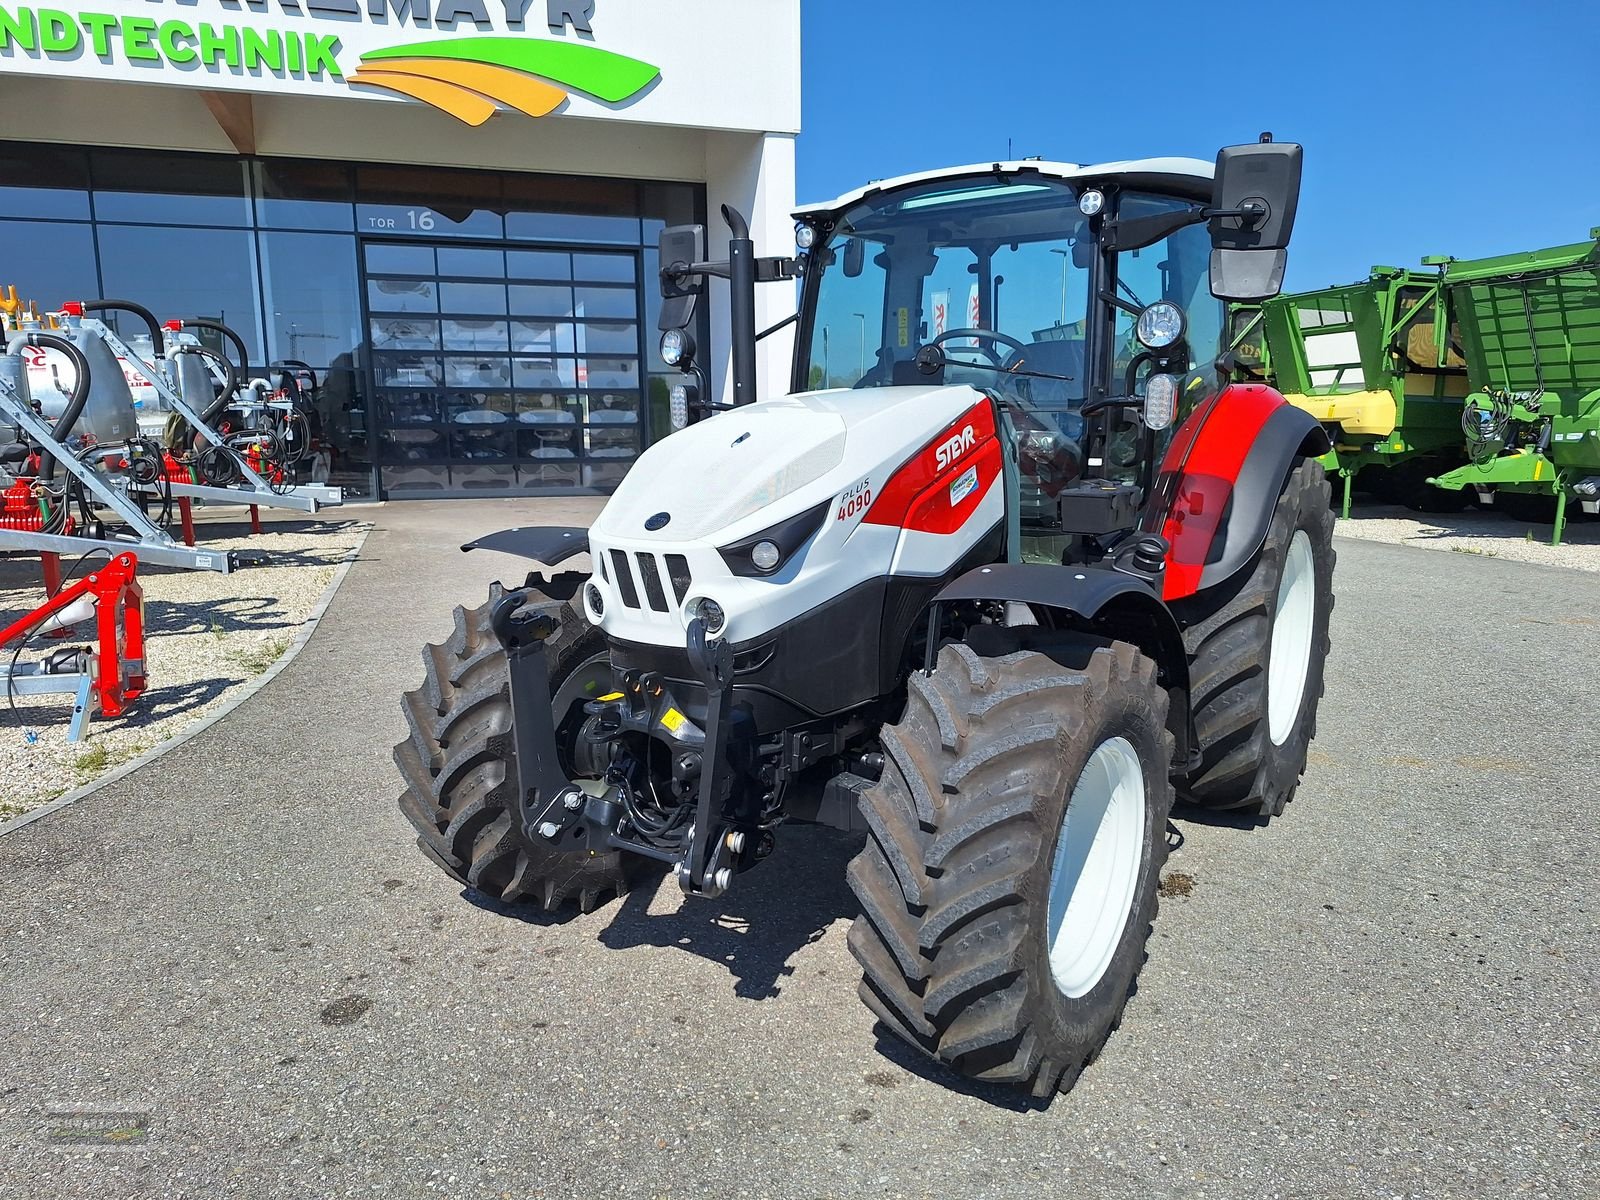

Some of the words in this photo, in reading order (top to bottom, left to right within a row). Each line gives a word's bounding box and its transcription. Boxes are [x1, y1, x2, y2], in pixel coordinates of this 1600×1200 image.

[0, 5, 343, 75] NDTECHNIK
[368, 217, 395, 228] TOR
[407, 210, 435, 230] 16
[936, 424, 975, 471] STEYR
[838, 490, 870, 520] 4090
[842, 478, 869, 503] PLUS
